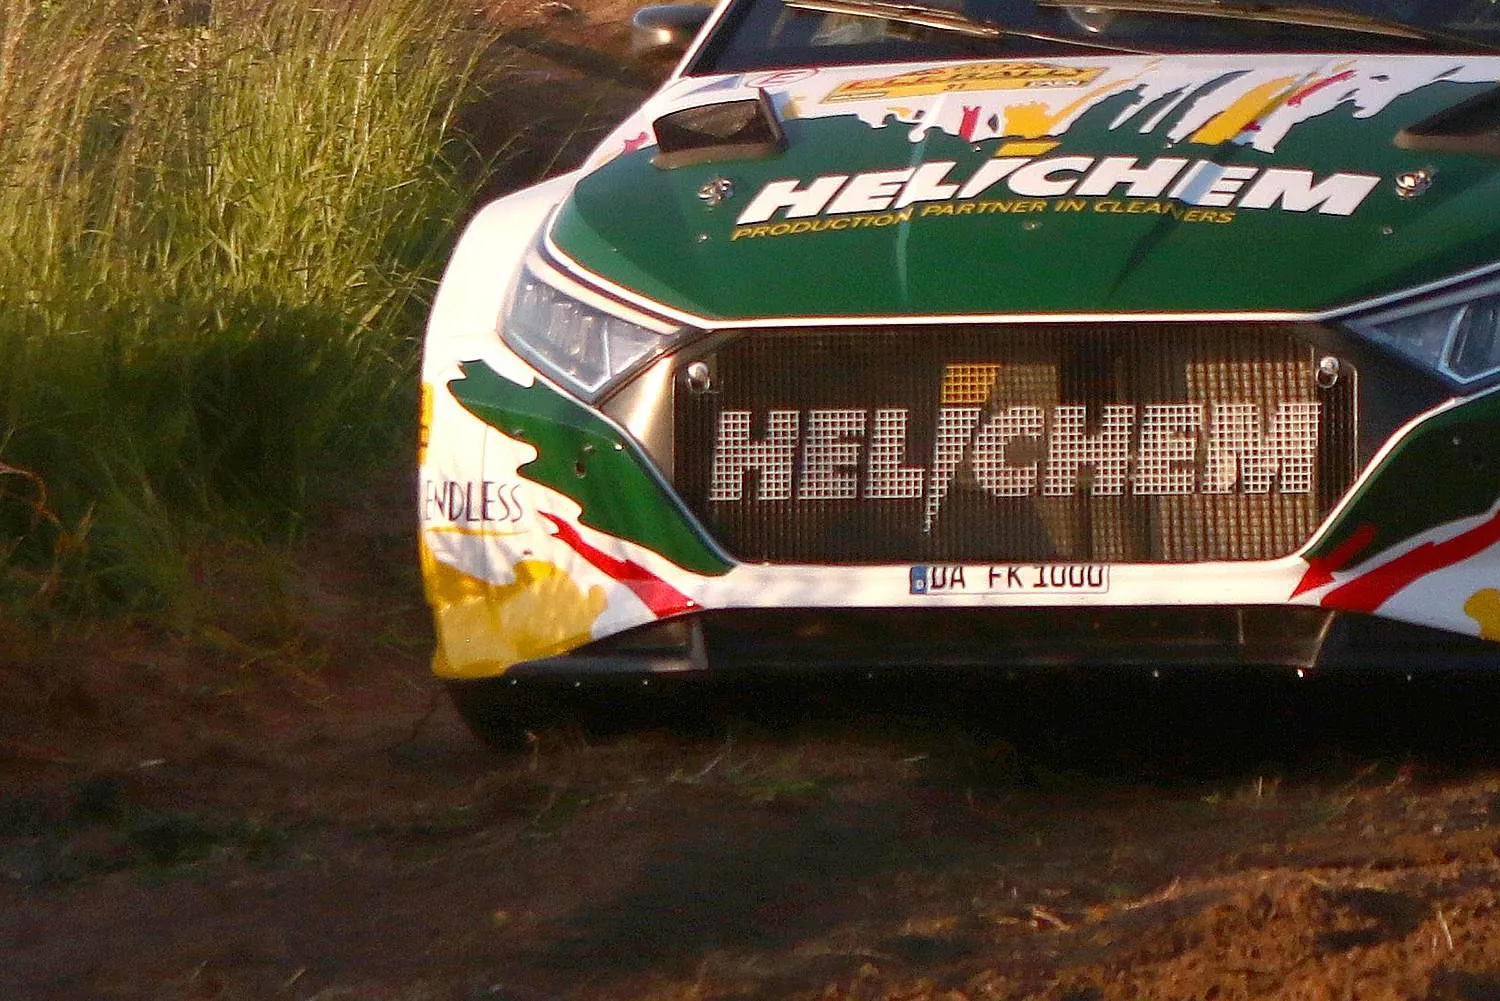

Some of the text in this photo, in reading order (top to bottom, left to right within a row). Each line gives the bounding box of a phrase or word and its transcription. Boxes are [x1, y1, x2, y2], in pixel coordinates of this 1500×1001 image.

[736, 141, 1381, 226] HELICHEM
[731, 199, 1236, 241] PRODUCTION PARTNER IN CLEANERS
[708, 363, 1322, 532] HELICHEM
[424, 479, 523, 523] ENDLESS
